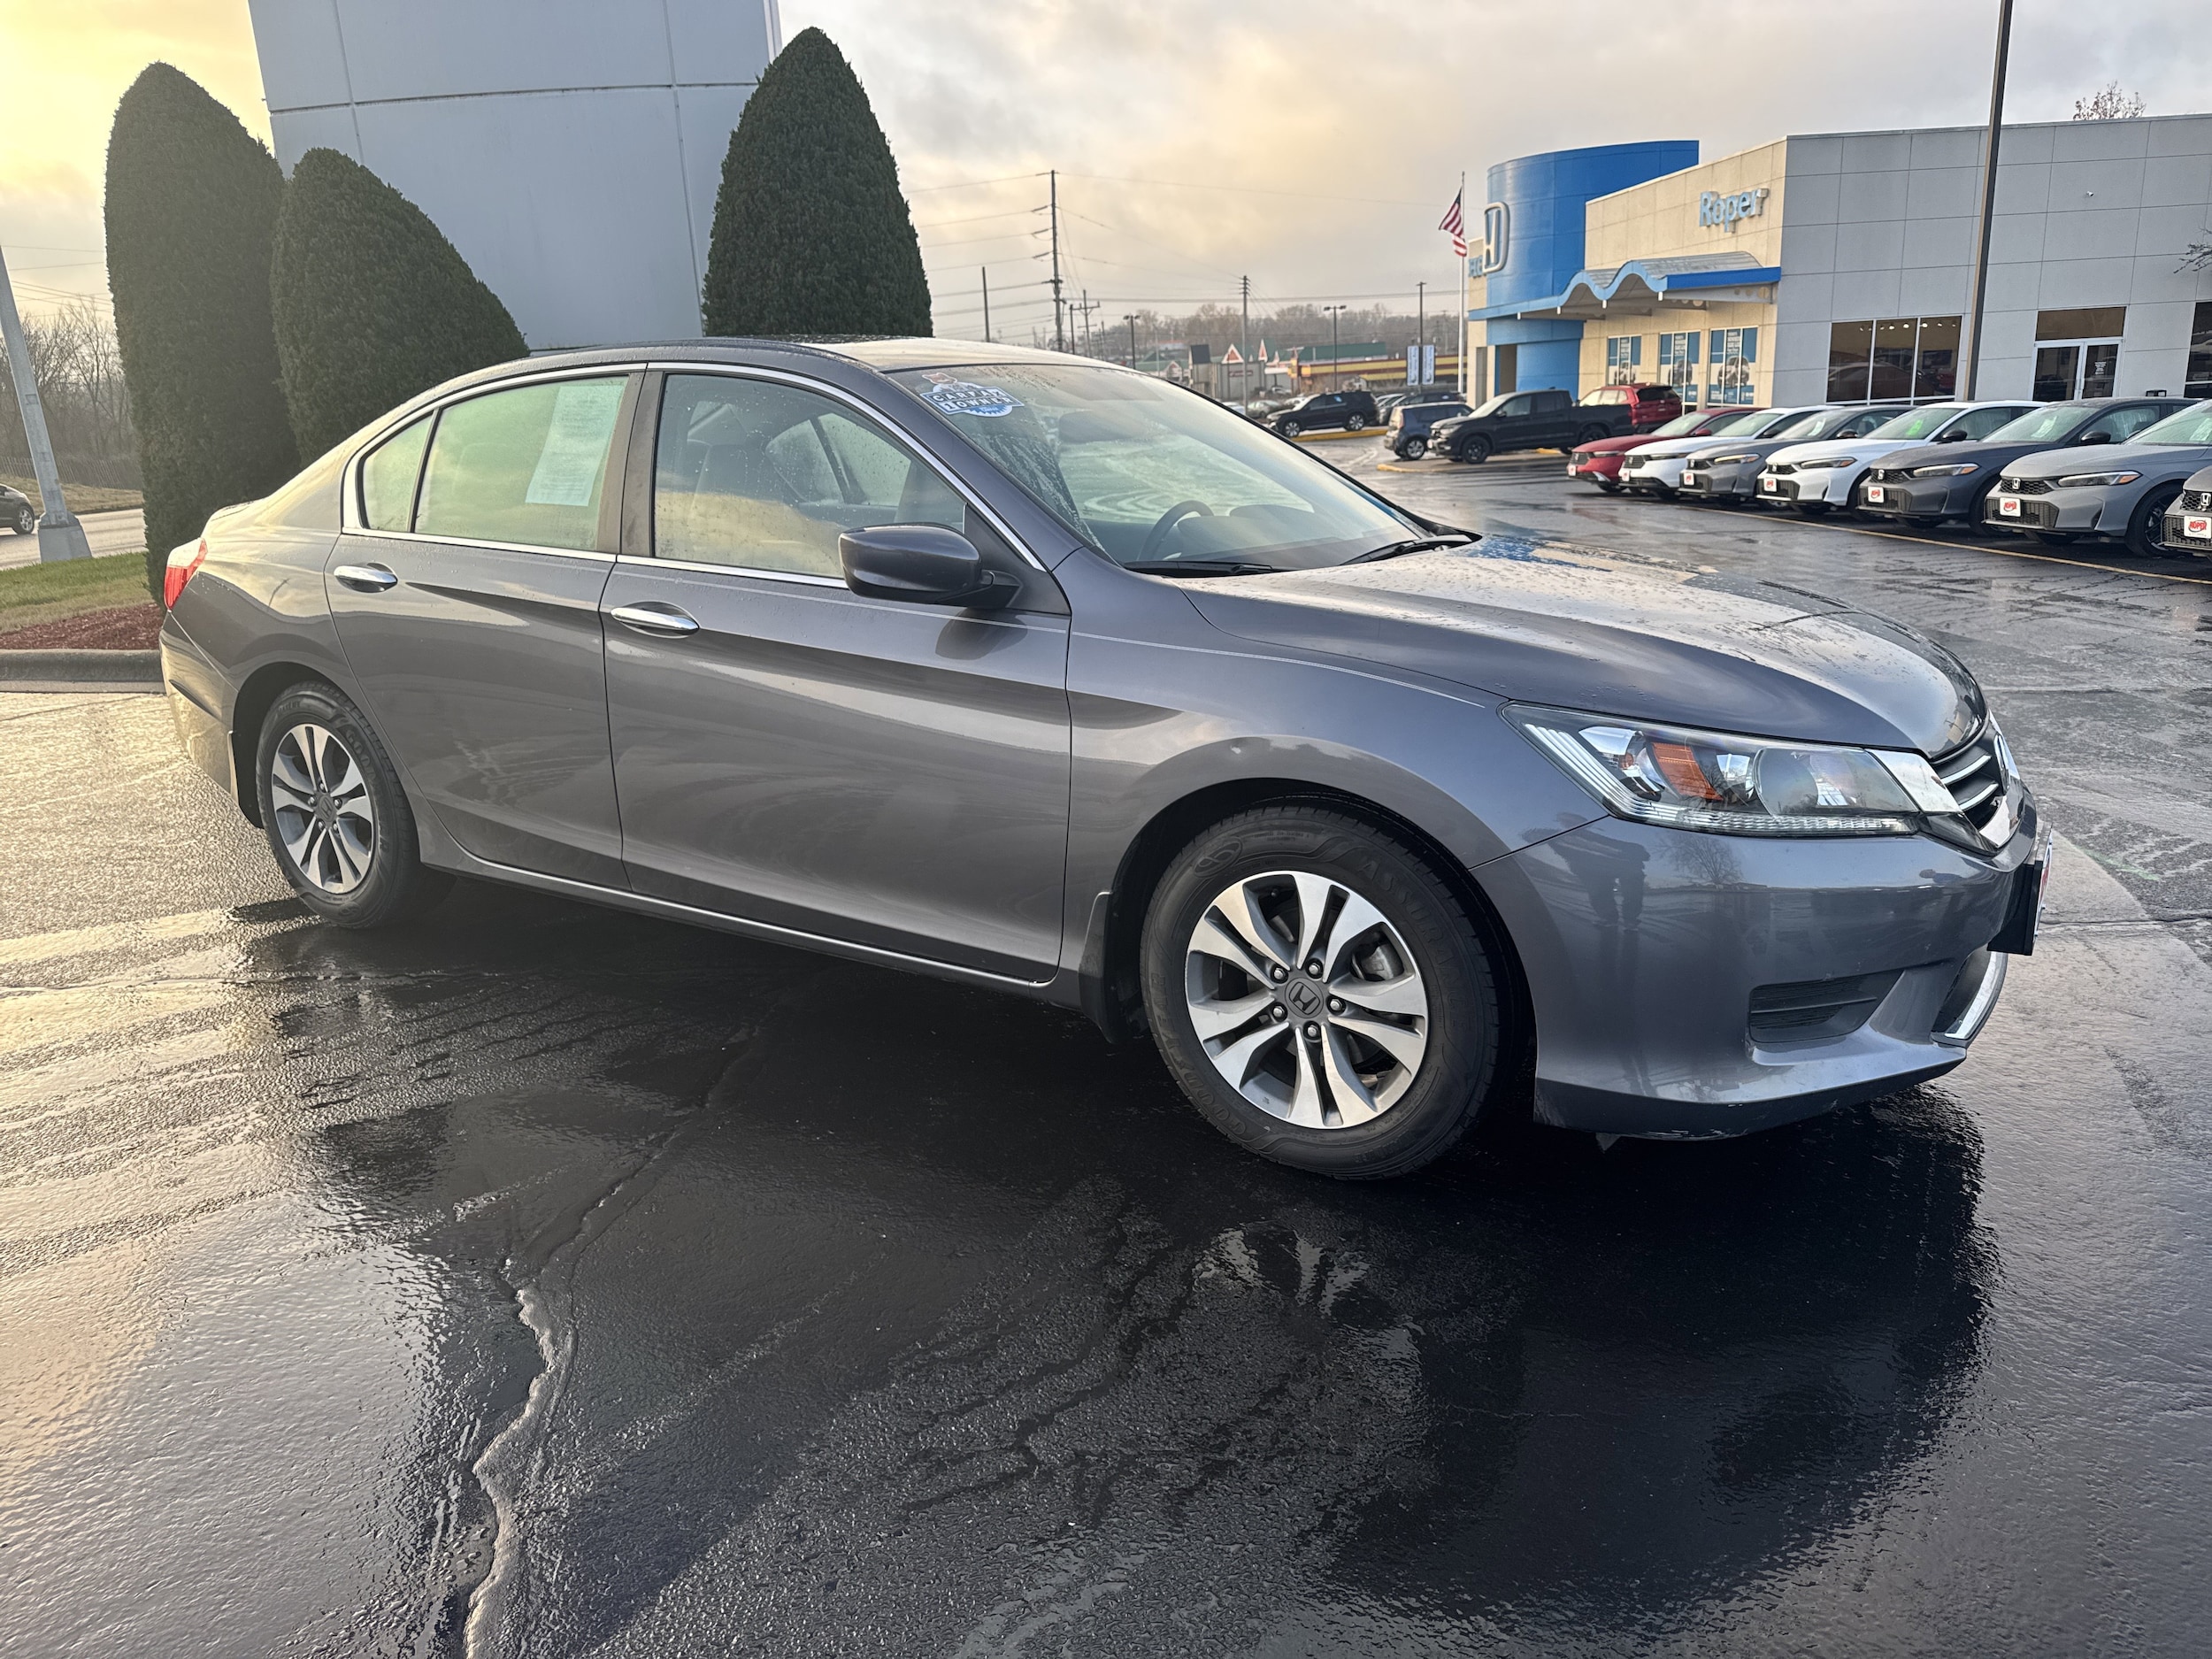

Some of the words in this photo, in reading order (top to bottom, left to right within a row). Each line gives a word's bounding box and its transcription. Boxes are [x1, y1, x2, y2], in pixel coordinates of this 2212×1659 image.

[1699, 188, 1769, 234] Roper
[932, 389, 1006, 403] CARFAX
[1357, 856, 1472, 1029] ASSURANCE
